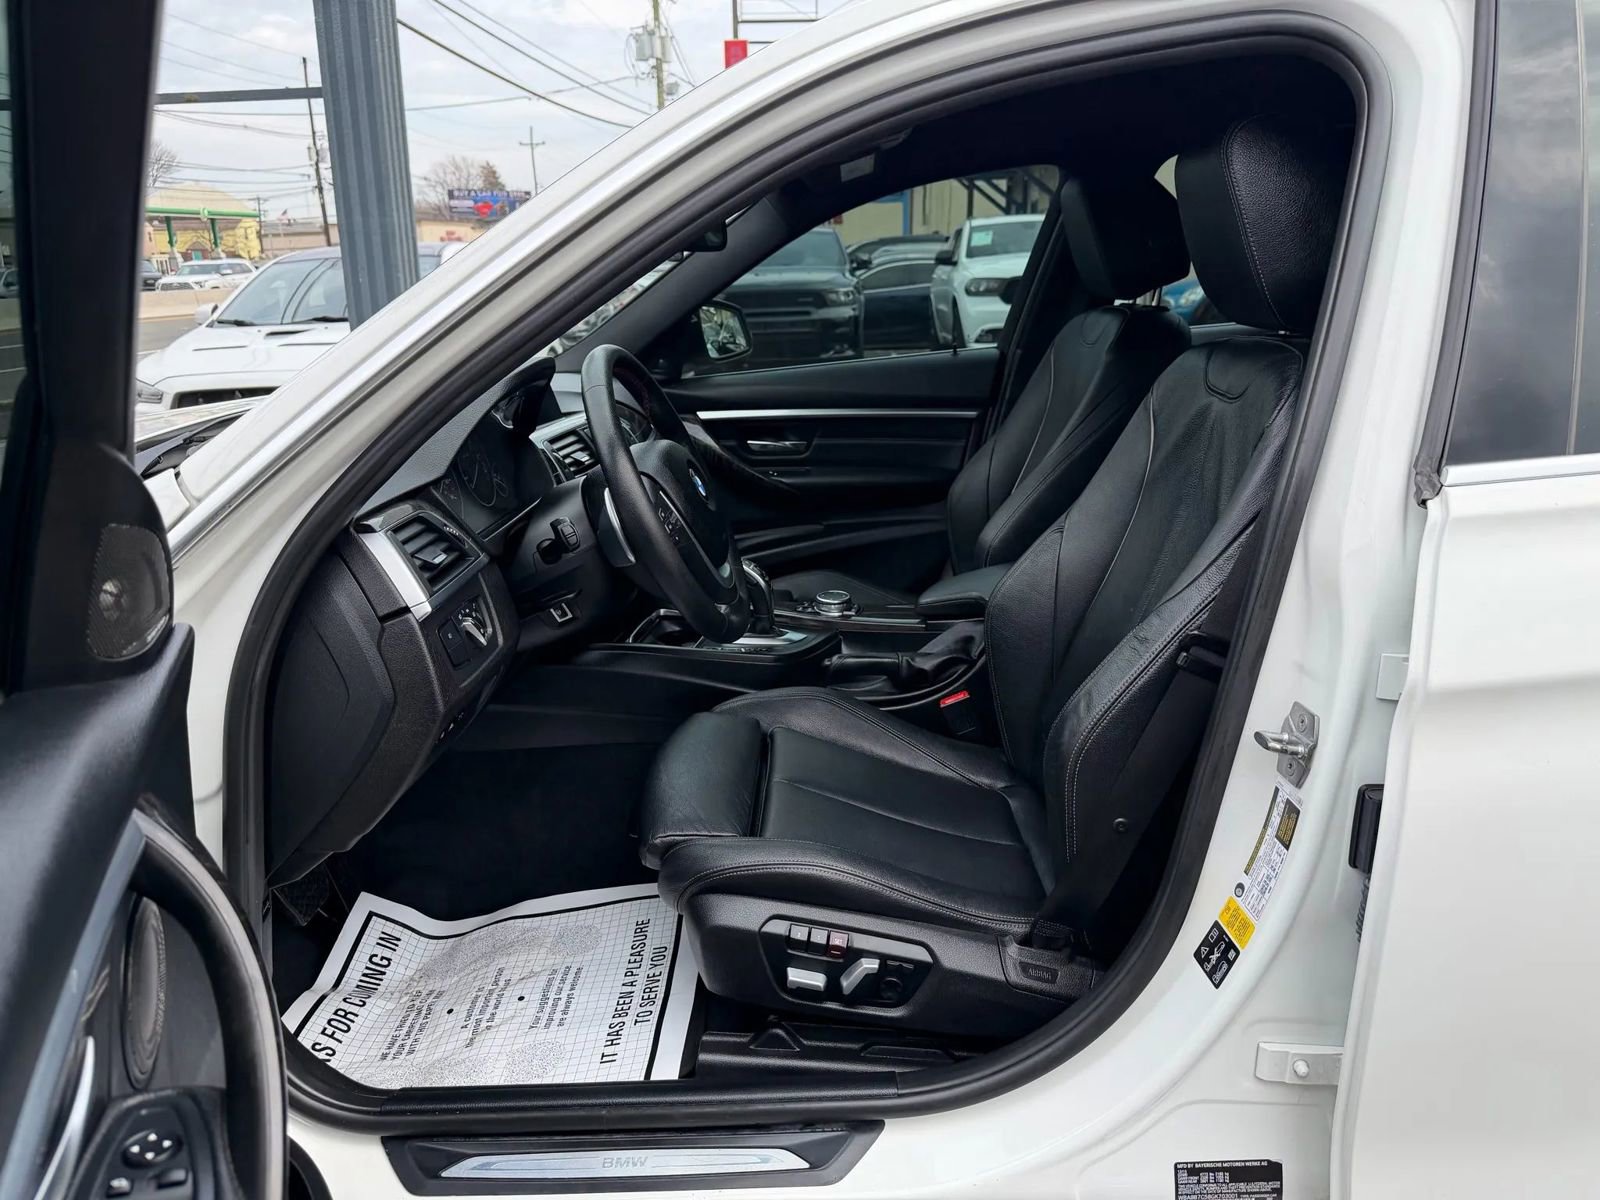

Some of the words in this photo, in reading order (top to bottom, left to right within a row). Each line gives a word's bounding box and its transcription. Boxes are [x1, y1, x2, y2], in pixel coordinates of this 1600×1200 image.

[624, 918, 650, 978] PLEASURE
[648, 945, 668, 970] YOU
[321, 1008, 359, 1044] FOR
[342, 953, 393, 1008] COMING
[376, 931, 402, 952] IN
[472, 1017, 484, 1036] most
[479, 988, 497, 1016] important
[491, 967, 505, 987] person
[639, 970, 663, 1008] SERVE
[464, 994, 481, 1023] customer
[486, 1011, 497, 1023] the
[492, 992, 504, 1011] world
[528, 1015, 541, 1030] Your
[536, 976, 556, 1014] suggestions
[543, 997, 562, 1030] improving
[555, 986, 563, 996] our
[560, 992, 575, 1016] always
[612, 990, 635, 1019] BEEN
[385, 1034, 400, 1051] HAVE
[394, 1013, 411, 1033] TRIED
[405, 1003, 416, 1014] TO
[557, 1017, 567, 1027] are
[634, 1010, 653, 1026] TO
[405, 1037, 421, 1057] WITH
[415, 1021, 429, 1037] THIS
[604, 1021, 626, 1048] HAS
[392, 1042, 407, 1060] YOUR
[600, 1052, 618, 1064] IT
[601, 1156, 648, 1169] BMW
